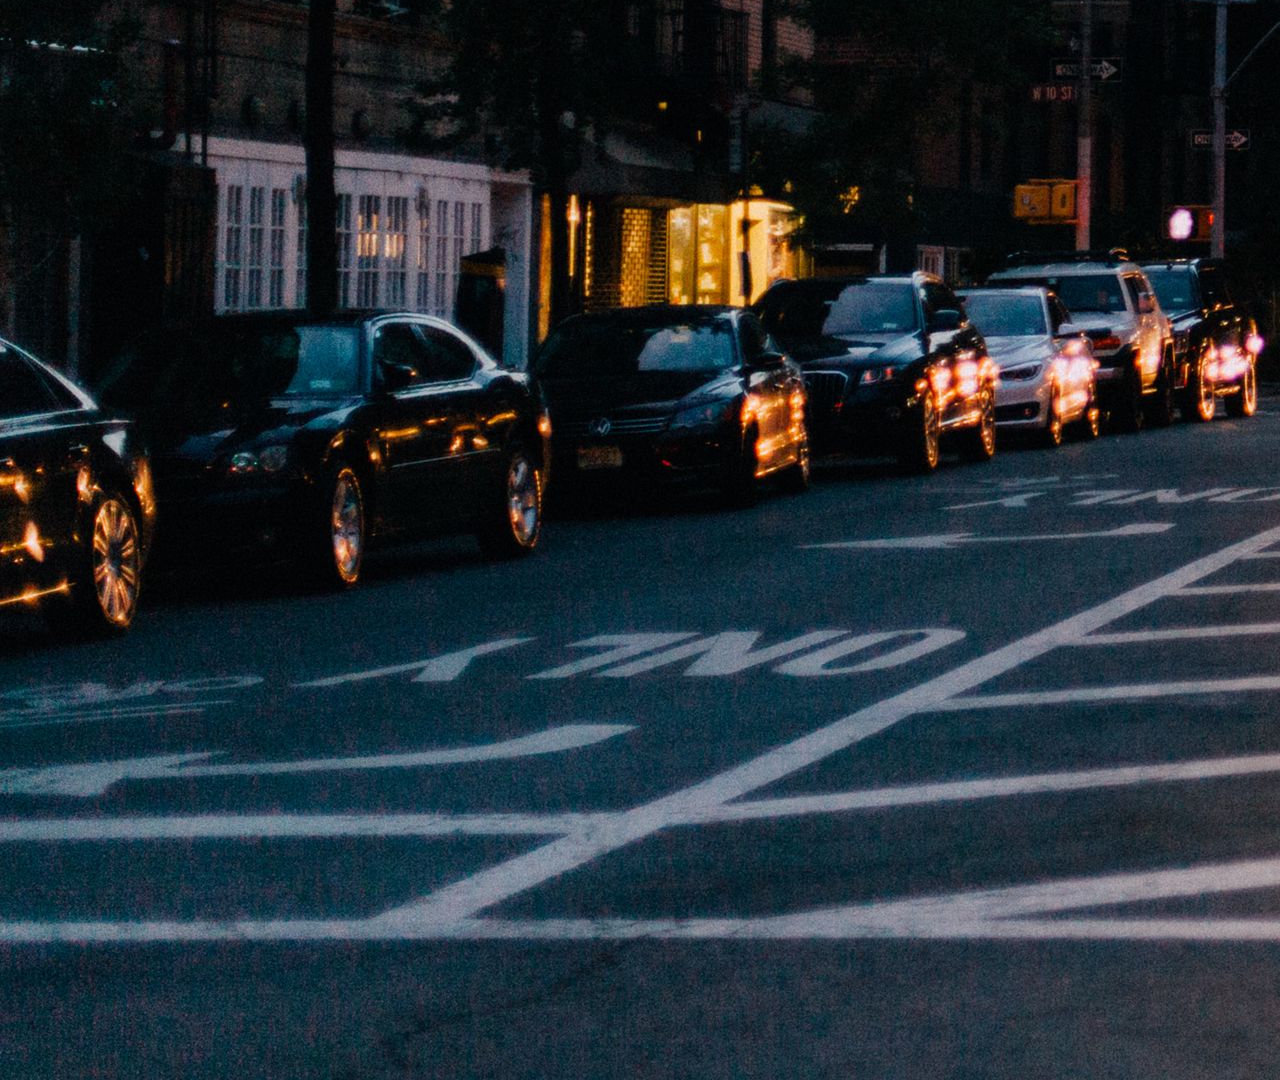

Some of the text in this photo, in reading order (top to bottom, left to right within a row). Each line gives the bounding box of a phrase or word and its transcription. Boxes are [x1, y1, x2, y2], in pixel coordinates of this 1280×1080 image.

[1090, 65, 1111, 75] WAY
[1031, 86, 1073, 101] W 10 ST
[291, 627, 967, 688] ONLY
